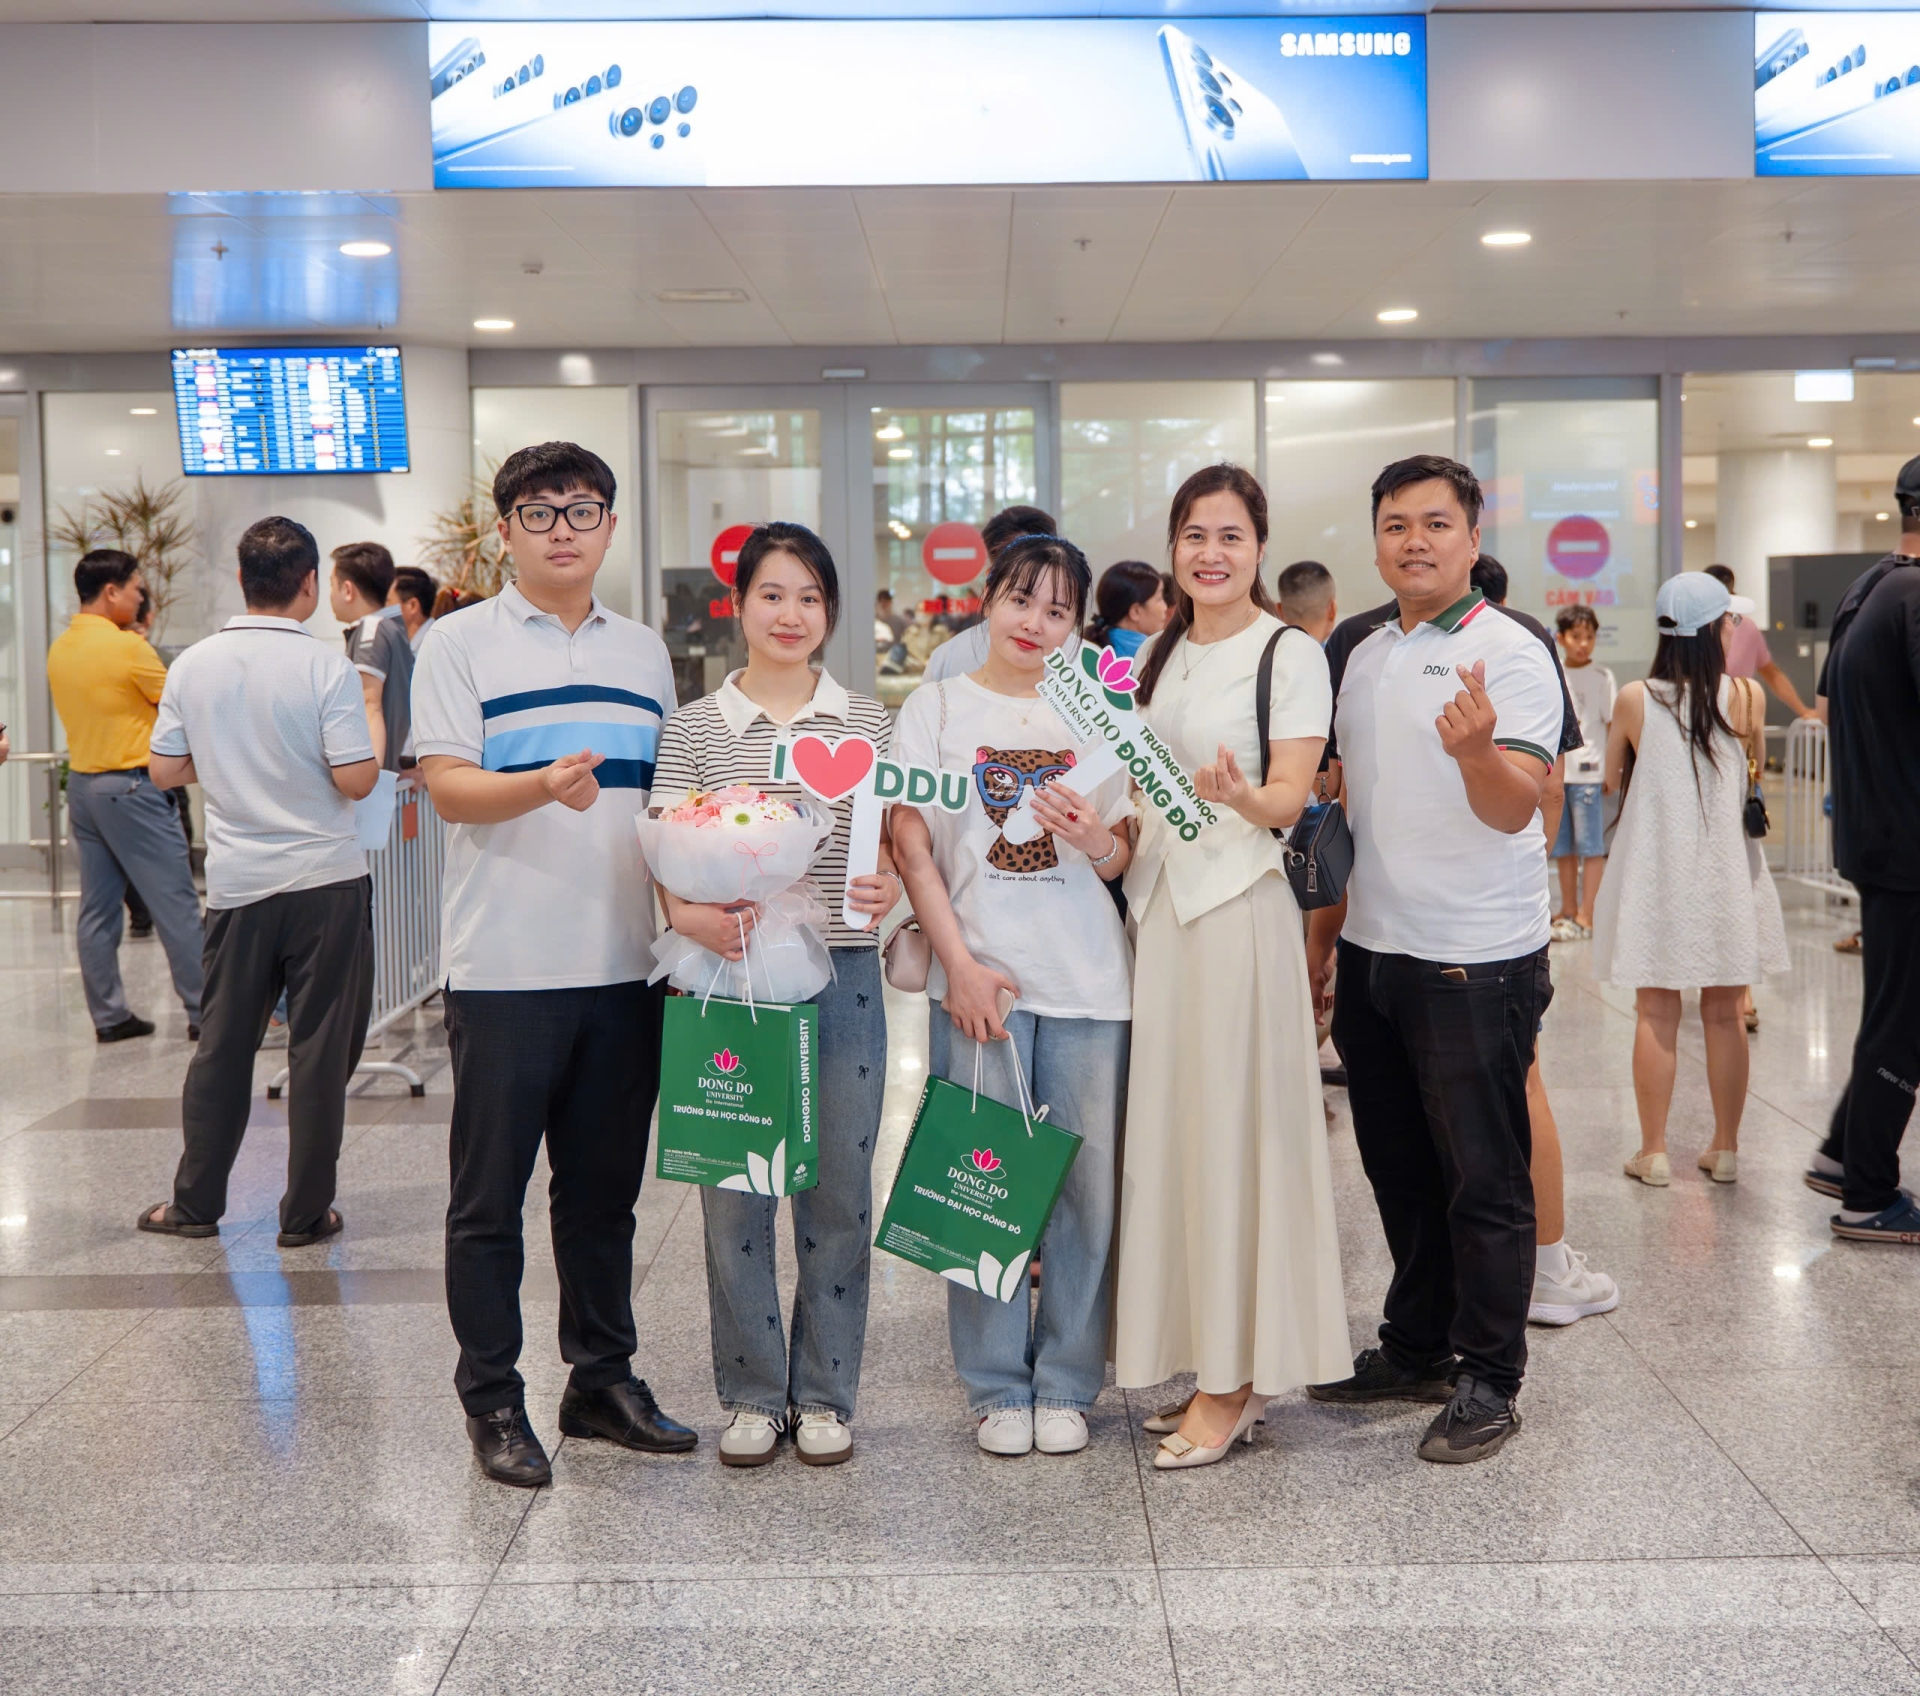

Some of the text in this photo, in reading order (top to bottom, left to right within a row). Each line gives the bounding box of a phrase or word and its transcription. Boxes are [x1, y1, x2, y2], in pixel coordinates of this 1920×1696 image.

[1280, 32, 1411, 57] SAMSUNG
[1423, 665, 1450, 677] DDU
[1047, 652, 1120, 741] DONG DO
[1047, 677, 1096, 737] UNIVERSITY
[1038, 684, 1087, 745] Be International
[774, 744, 968, 810] I DDU
[1116, 741, 1202, 842] ĐÔNG ĐÔ
[698, 1076, 754, 1095] DONG DO
[799, 1018, 811, 1143] DONGDO UNIVERSITY
[1877, 1067, 1899, 1083] new
[706, 1091, 745, 1102] UNIVERSITY
[672, 1104, 704, 1116] TRƯỜNG
[720, 1111, 737, 1121] HỌC
[738, 1112, 760, 1124] ĐÔNG
[761, 1116, 773, 1126] ĐÔ
[947, 1166, 1008, 1200] DONG DO
[953, 1182, 995, 1203] UNIVERSITY
[913, 1184, 946, 1203] TRƯỜNG
[962, 1204, 982, 1217] HỌC
[982, 1213, 1007, 1229] ĐÔNG
[1008, 1224, 1022, 1235] ĐÔ
